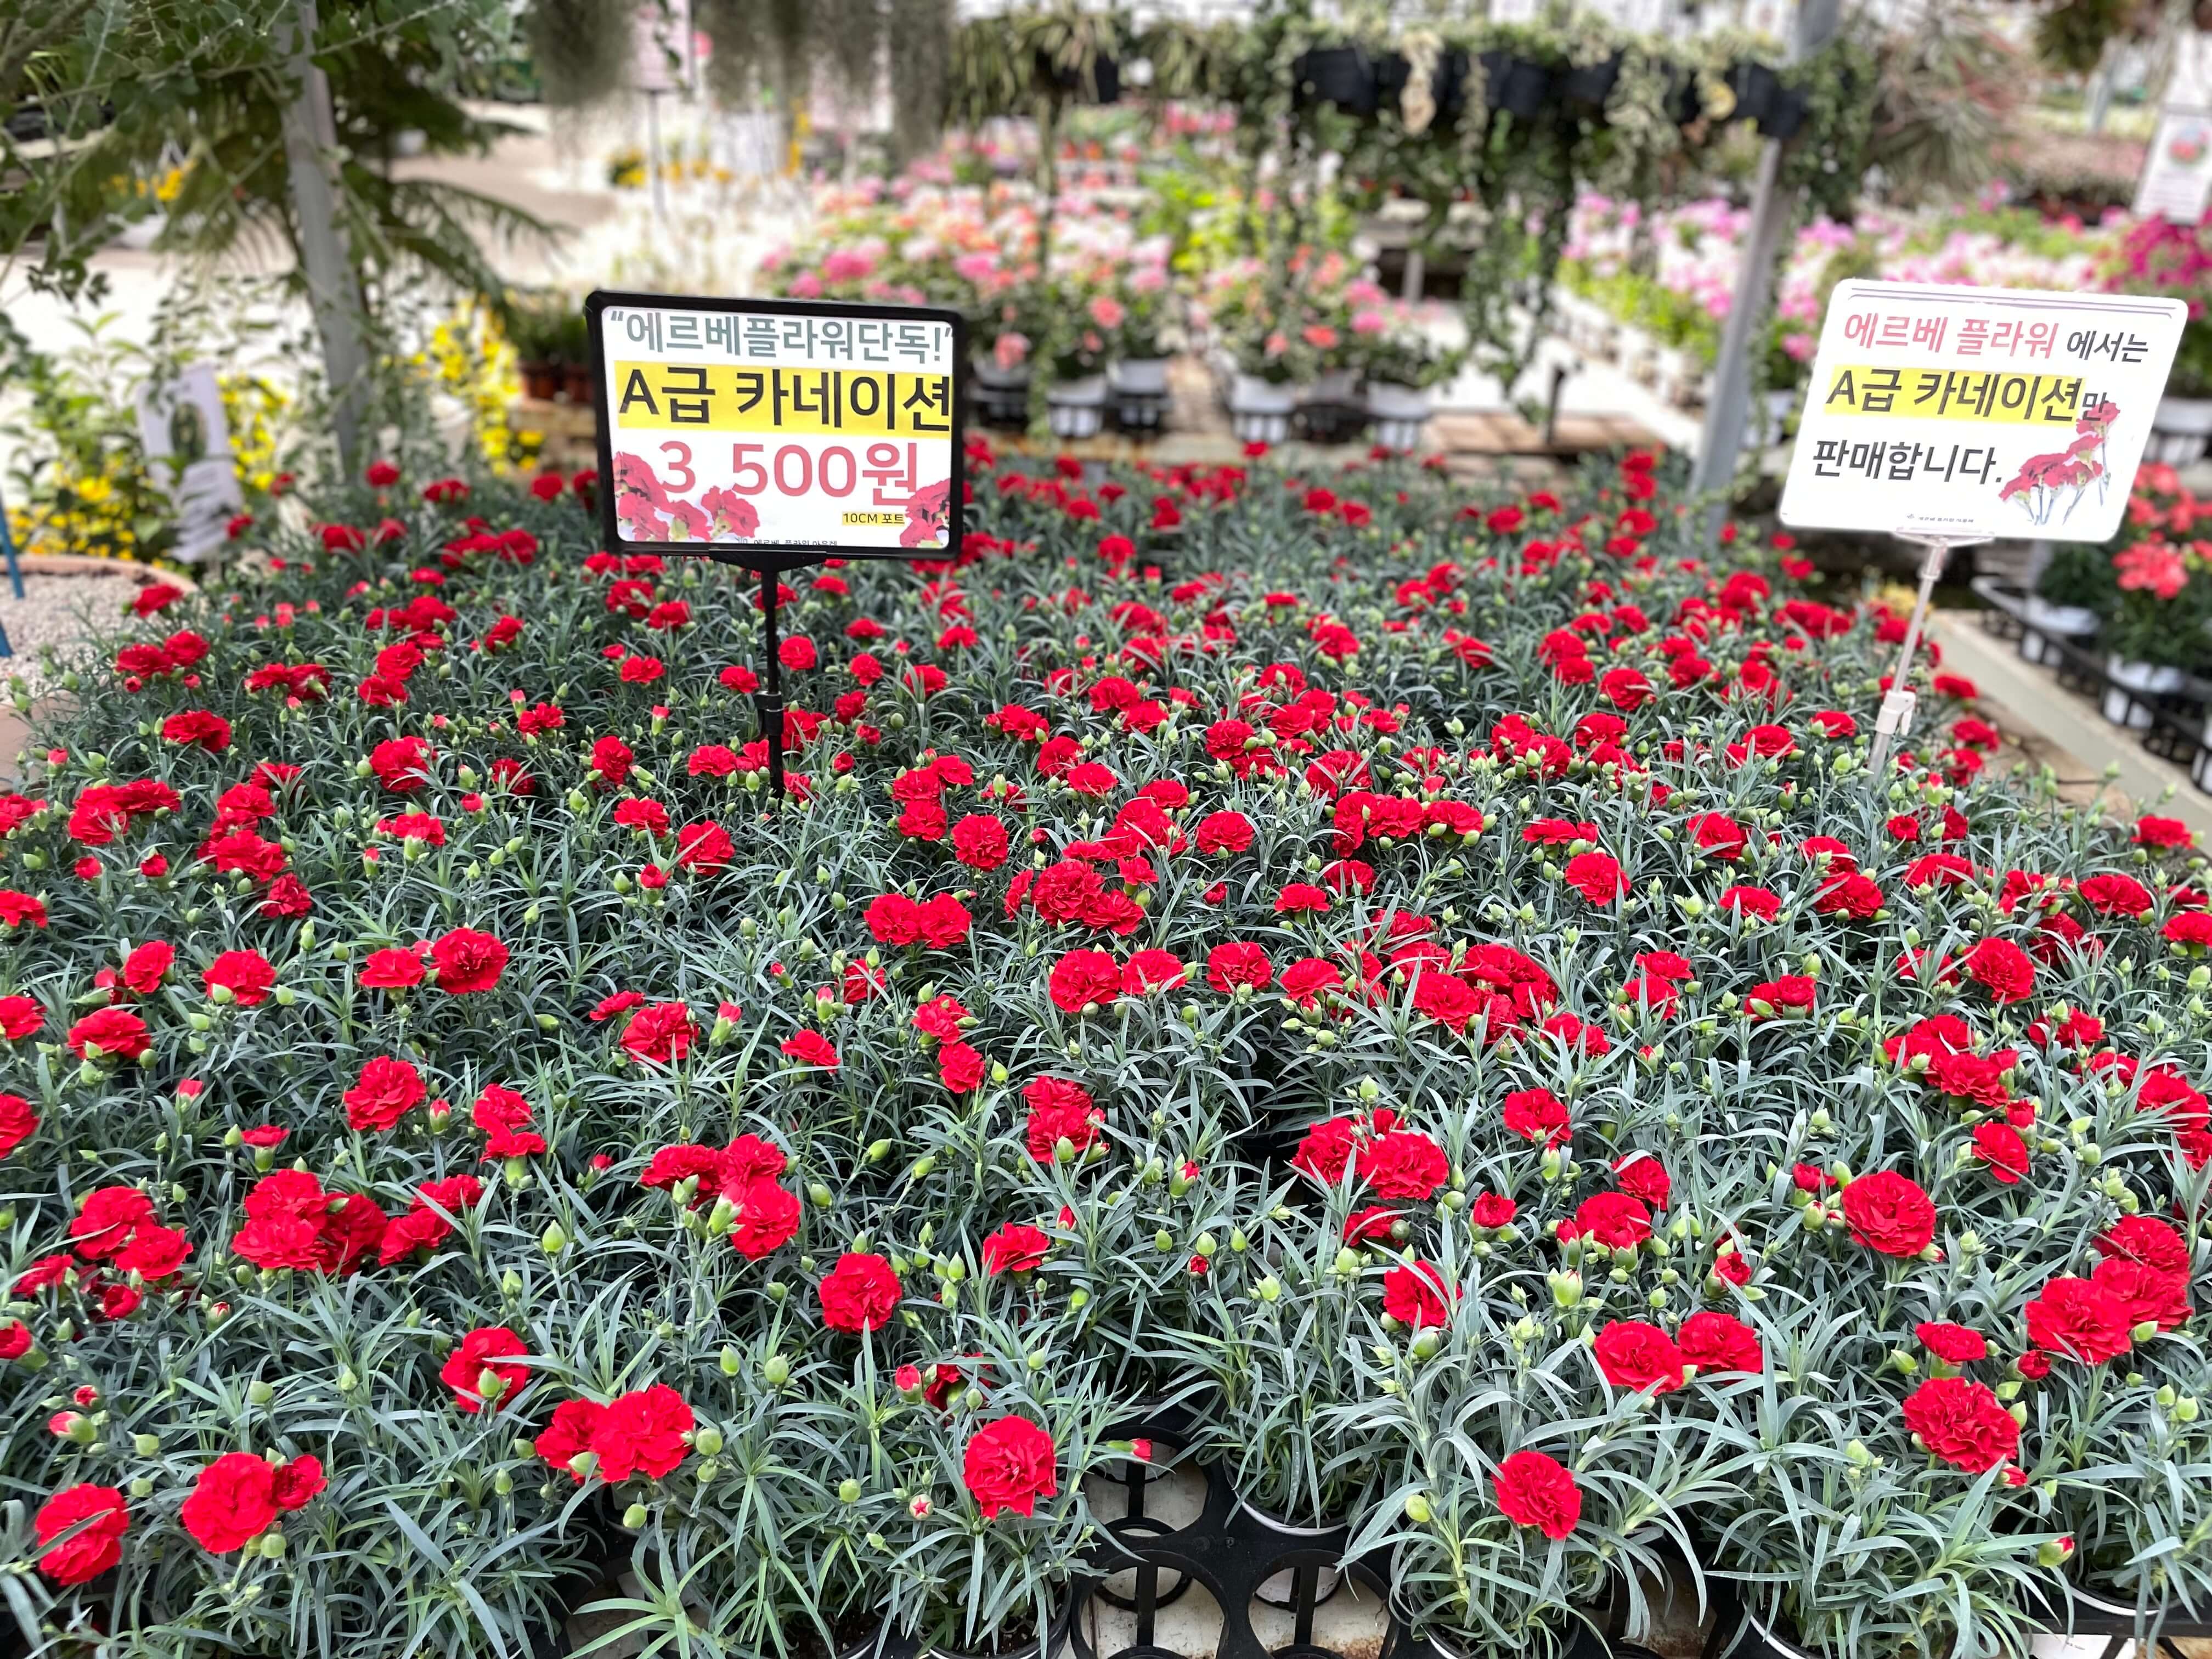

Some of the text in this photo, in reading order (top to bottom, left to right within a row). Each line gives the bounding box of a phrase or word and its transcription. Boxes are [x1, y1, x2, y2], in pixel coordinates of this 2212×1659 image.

[1844, 313, 2149, 363] 에르베 플라워 에서는
[619, 367, 950, 431] A급 카네이션
[1826, 369, 1903, 412] A급
[1812, 440, 2002, 485] 판매합니다.
[843, 513, 905, 524] 10CM 포트
